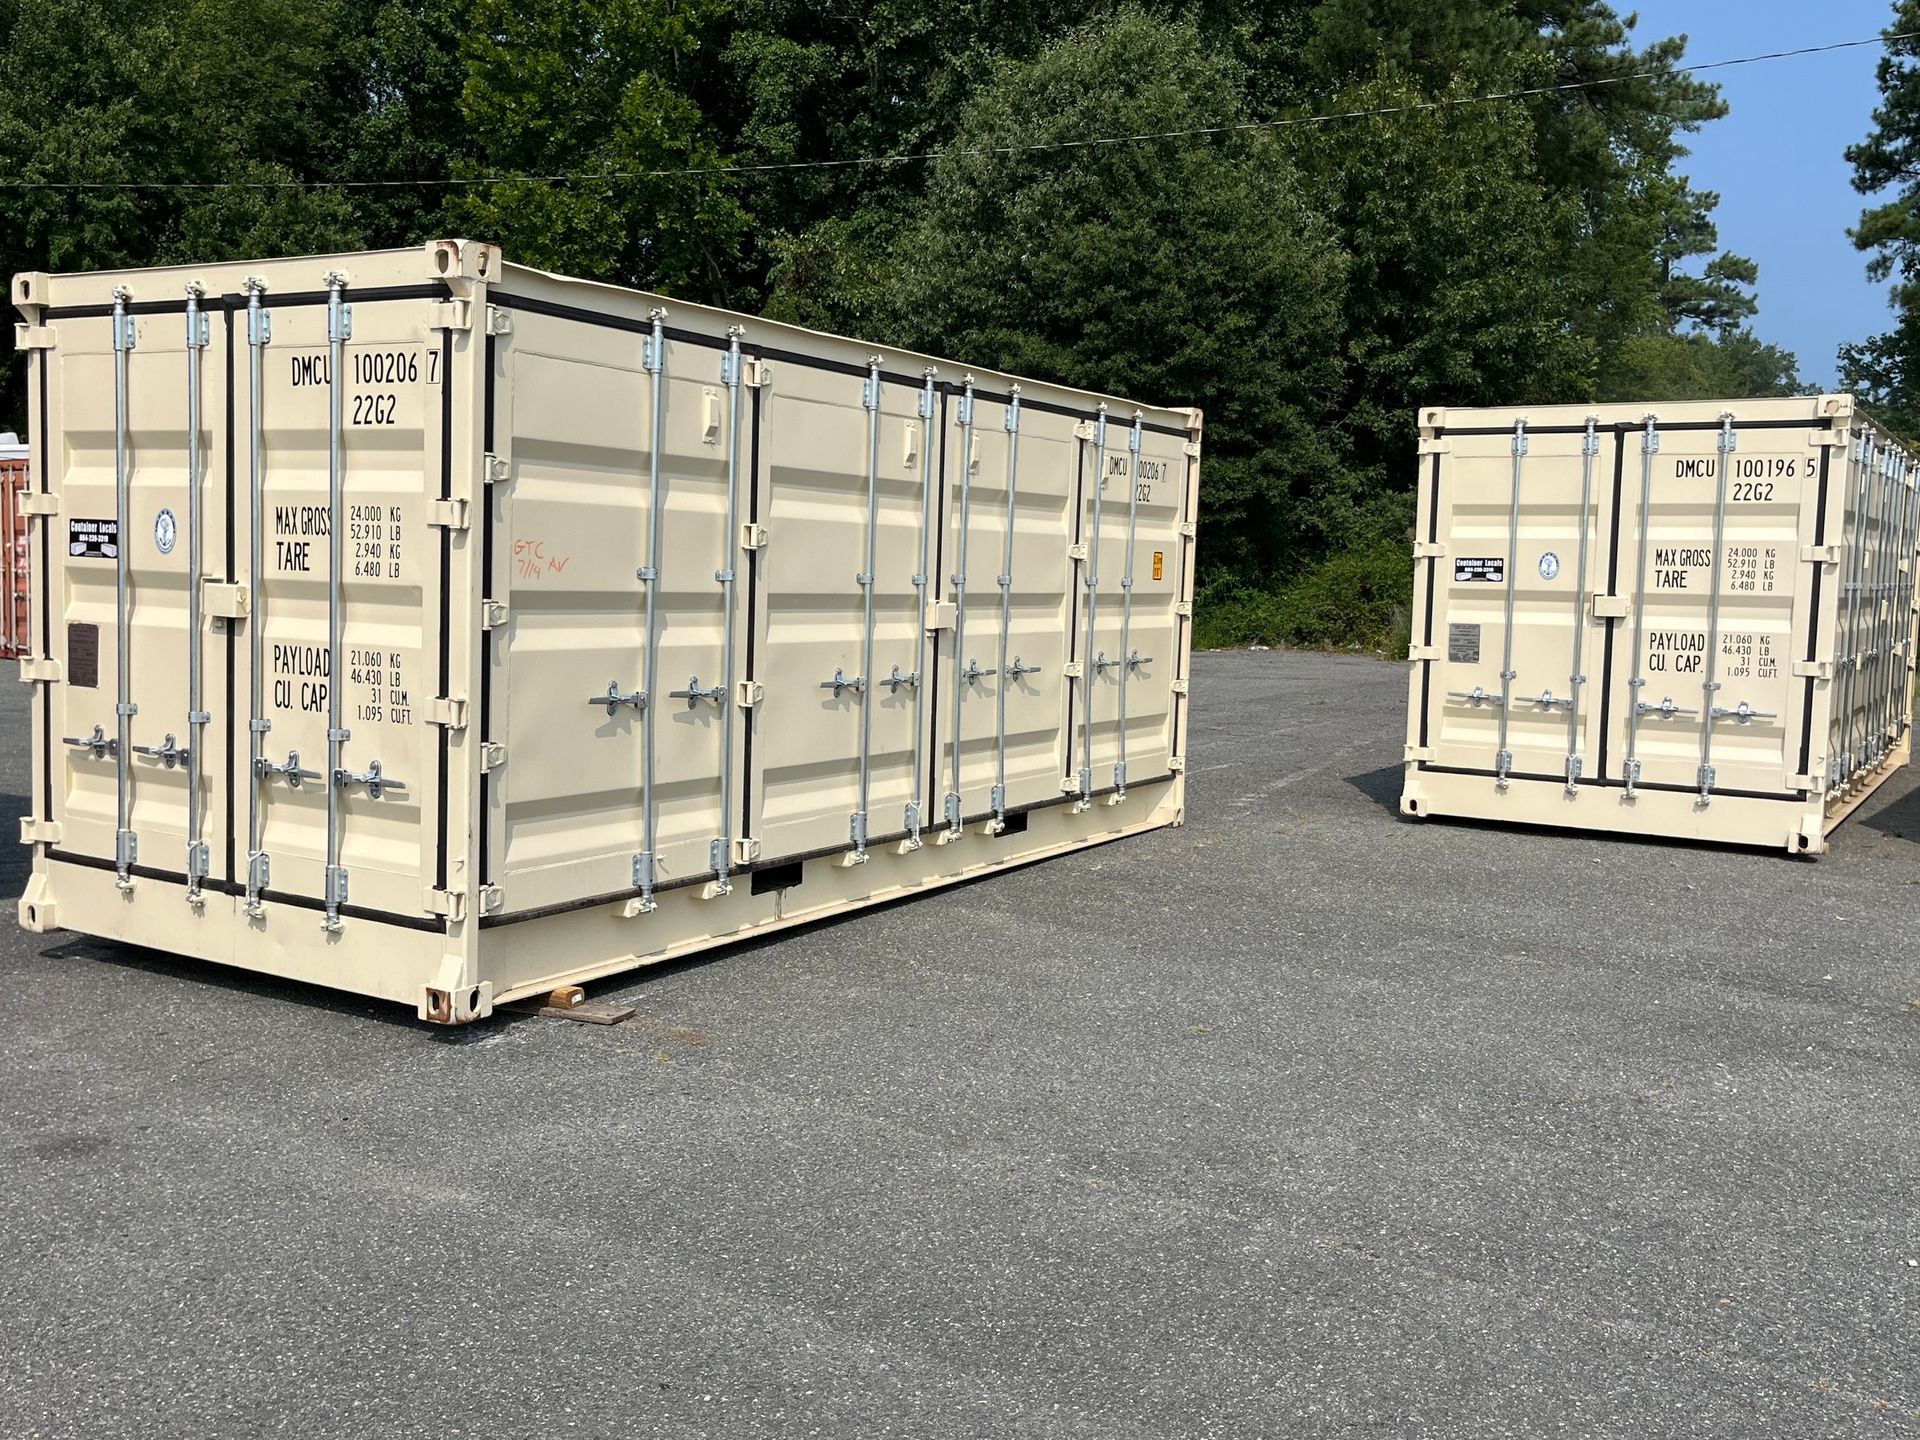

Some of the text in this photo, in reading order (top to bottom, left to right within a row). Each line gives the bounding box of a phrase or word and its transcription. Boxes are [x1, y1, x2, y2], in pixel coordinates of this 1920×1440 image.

[292, 351, 439, 386] DMCU 100206 7
[353, 394, 396, 425] 22G2
[1109, 456, 1128, 476] DMCU
[1676, 458, 1816, 478] DMCU 100196 5
[1135, 483, 1151, 502] 2G2
[1733, 482, 1774, 501] 22G2
[275, 506, 331, 536] MAX GROSS
[350, 505, 401, 522] 24.000 KG
[70, 520, 118, 534] Container Locals
[350, 524, 401, 541] 52.910 LB
[276, 541, 310, 571] TARE
[355, 542, 401, 560] 2.940 KG
[1655, 549, 1711, 567] MAX GROSS
[1728, 548, 1776, 558] 24.000 KG
[355, 561, 400, 578] 6.480 LB
[1456, 559, 1483, 567] Container
[1727, 558, 1775, 569] 52.910 LB
[1655, 570, 1688, 588] TARE
[1731, 569, 1774, 580] 2.940 KG
[1730, 581, 1773, 591] 6.480 LB
[1649, 632, 1705, 652] PAYLOAD
[1722, 634, 1771, 645] 21.060 KG
[351, 650, 401, 669] 21.060 KG
[1721, 645, 1770, 656] 46.430 LB
[274, 644, 330, 677] PAYLOAD
[1649, 653, 1704, 674] CU. CAP.
[1740, 656, 1751, 667] 31
[350, 668, 401, 687] 46.430 LB
[1727, 666, 1750, 678] 1.095
[274, 680, 293, 709] CU.
[371, 688, 382, 703] 31
[358, 704, 382, 722] 1.095
